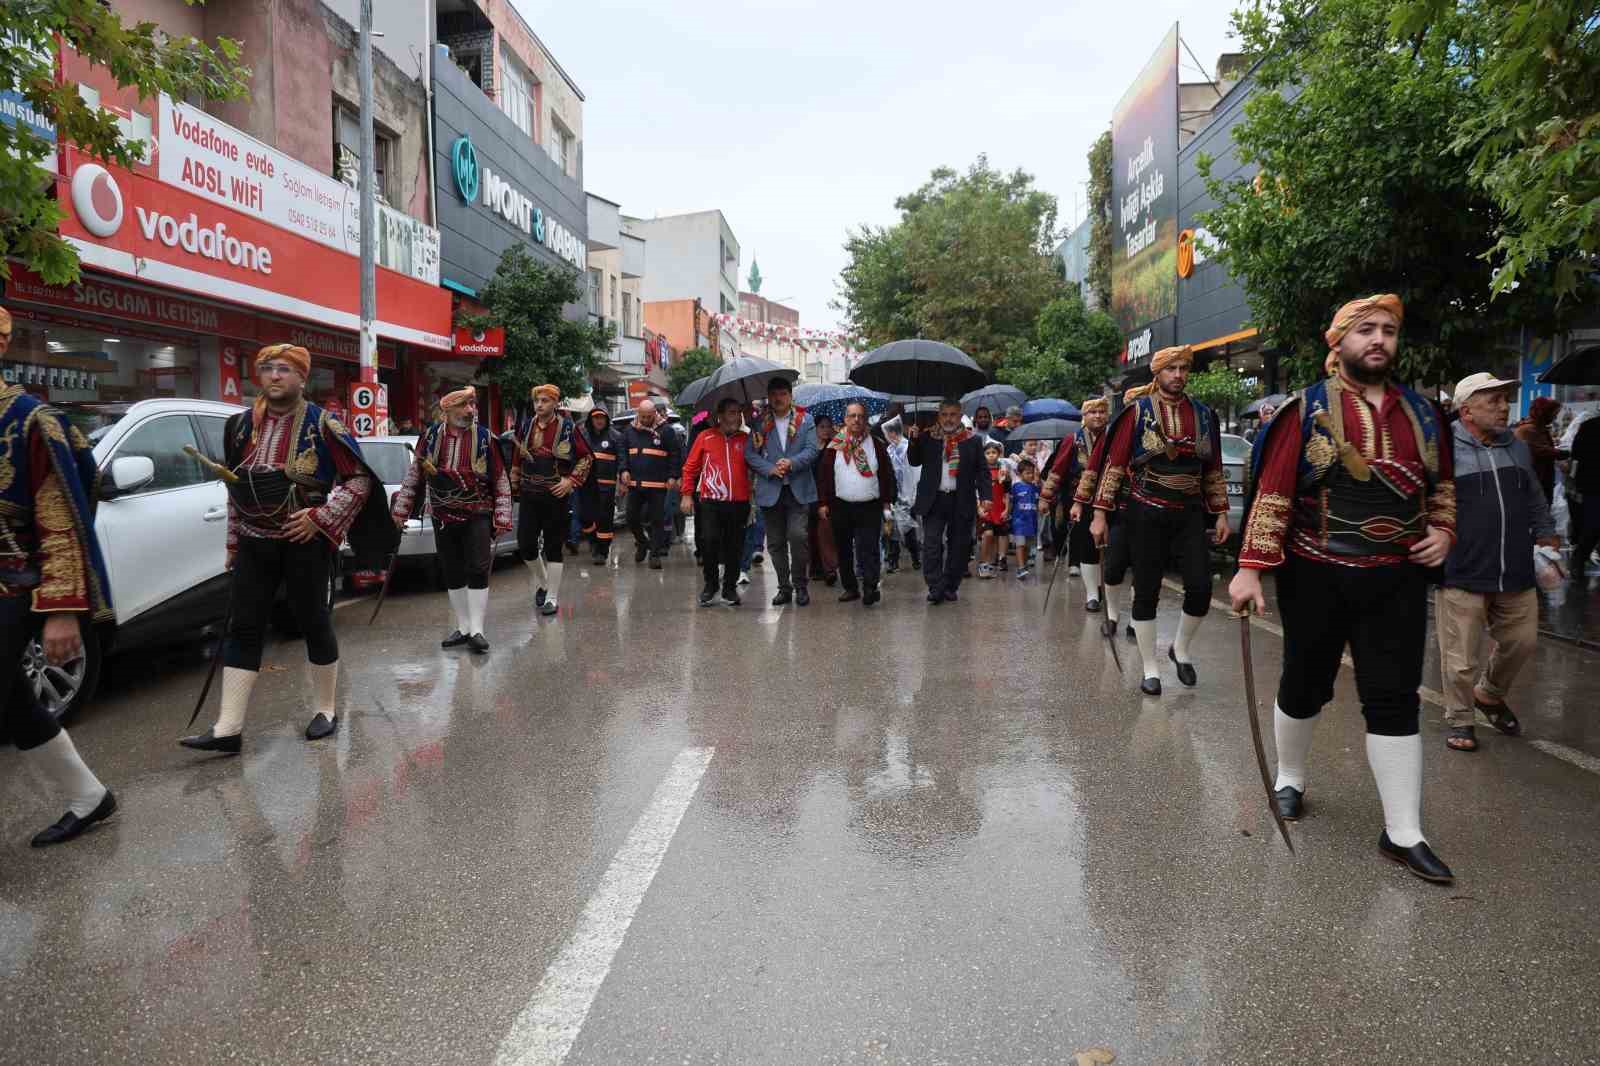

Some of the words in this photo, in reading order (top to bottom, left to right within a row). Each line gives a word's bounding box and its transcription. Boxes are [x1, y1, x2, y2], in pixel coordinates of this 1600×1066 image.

[0, 99, 54, 132] MSUNG
[172, 109, 238, 161] Vodafone
[246, 152, 274, 178] evde
[182, 157, 226, 197] ADSL
[482, 167, 532, 234] MONT
[533, 208, 544, 243] &
[136, 206, 273, 275] vodafone
[459, 344, 499, 353] vodafone
[358, 390, 370, 406] 6
[354, 417, 372, 432] 12
